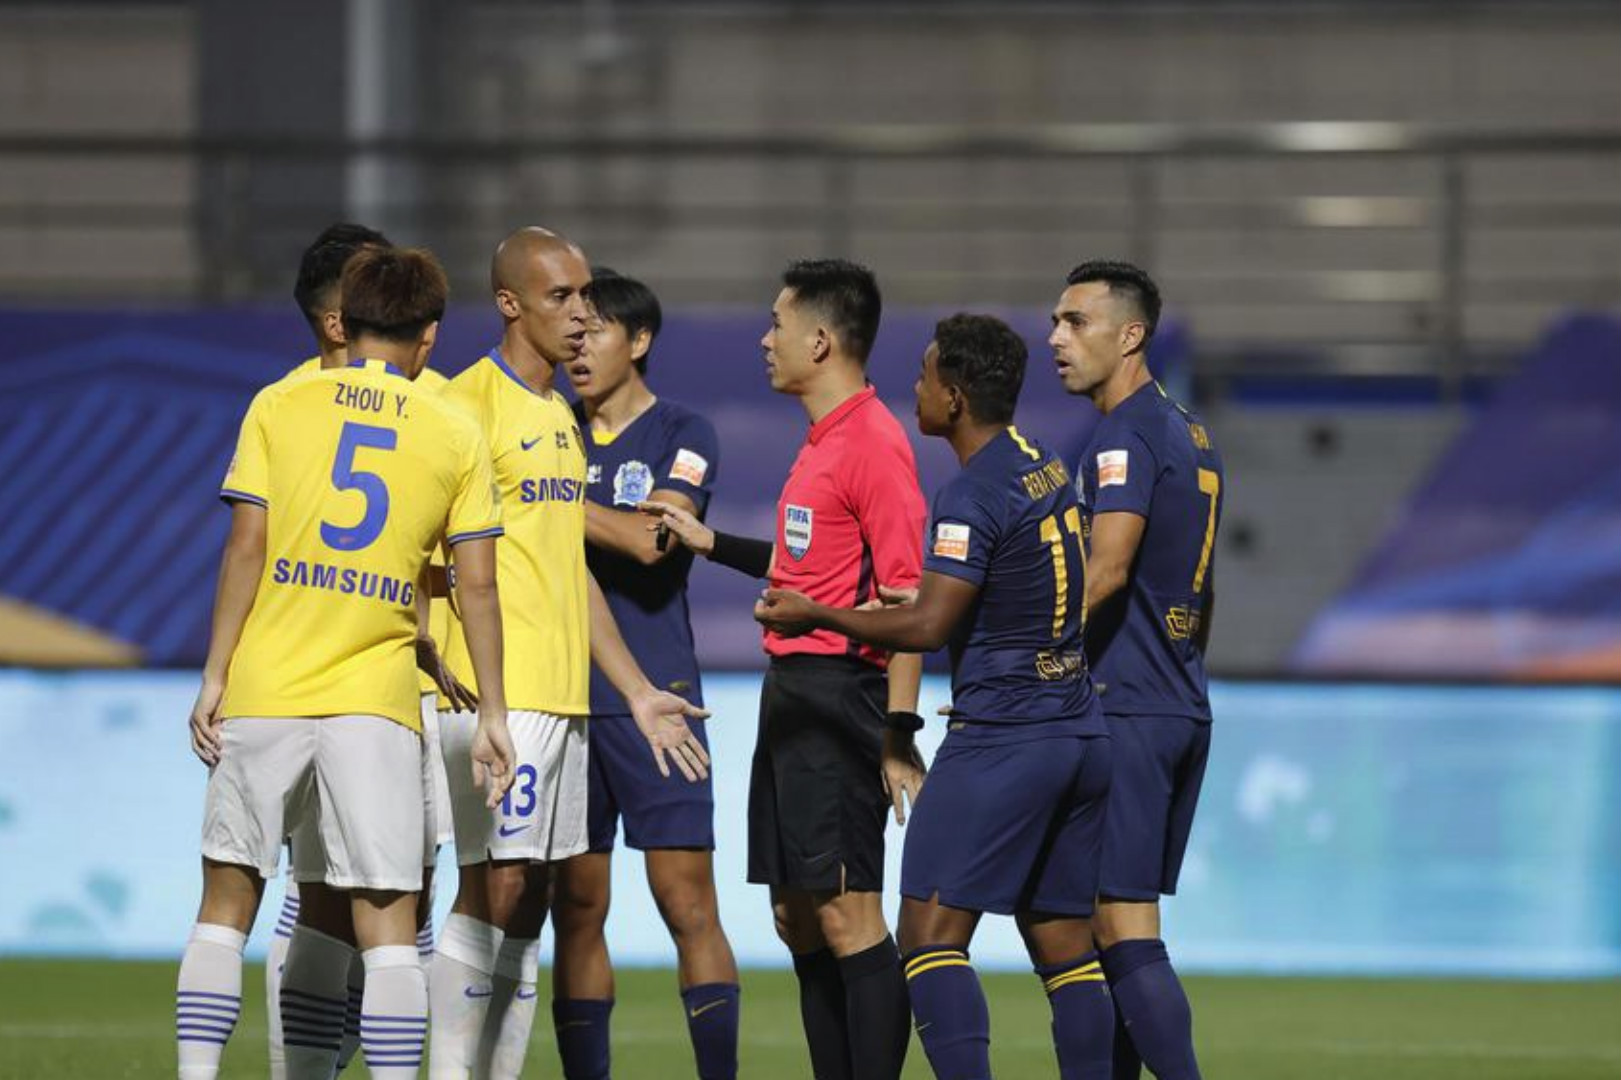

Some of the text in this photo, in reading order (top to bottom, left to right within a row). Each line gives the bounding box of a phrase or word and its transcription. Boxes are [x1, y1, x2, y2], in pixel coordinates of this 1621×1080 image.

[334, 382, 409, 419] ZHOU Y.
[319, 420, 398, 552] 5
[787, 507, 809, 524] FIFA
[1039, 505, 1089, 639] 11
[1192, 467, 1219, 594] 7
[273, 558, 414, 607] SAMSUNG
